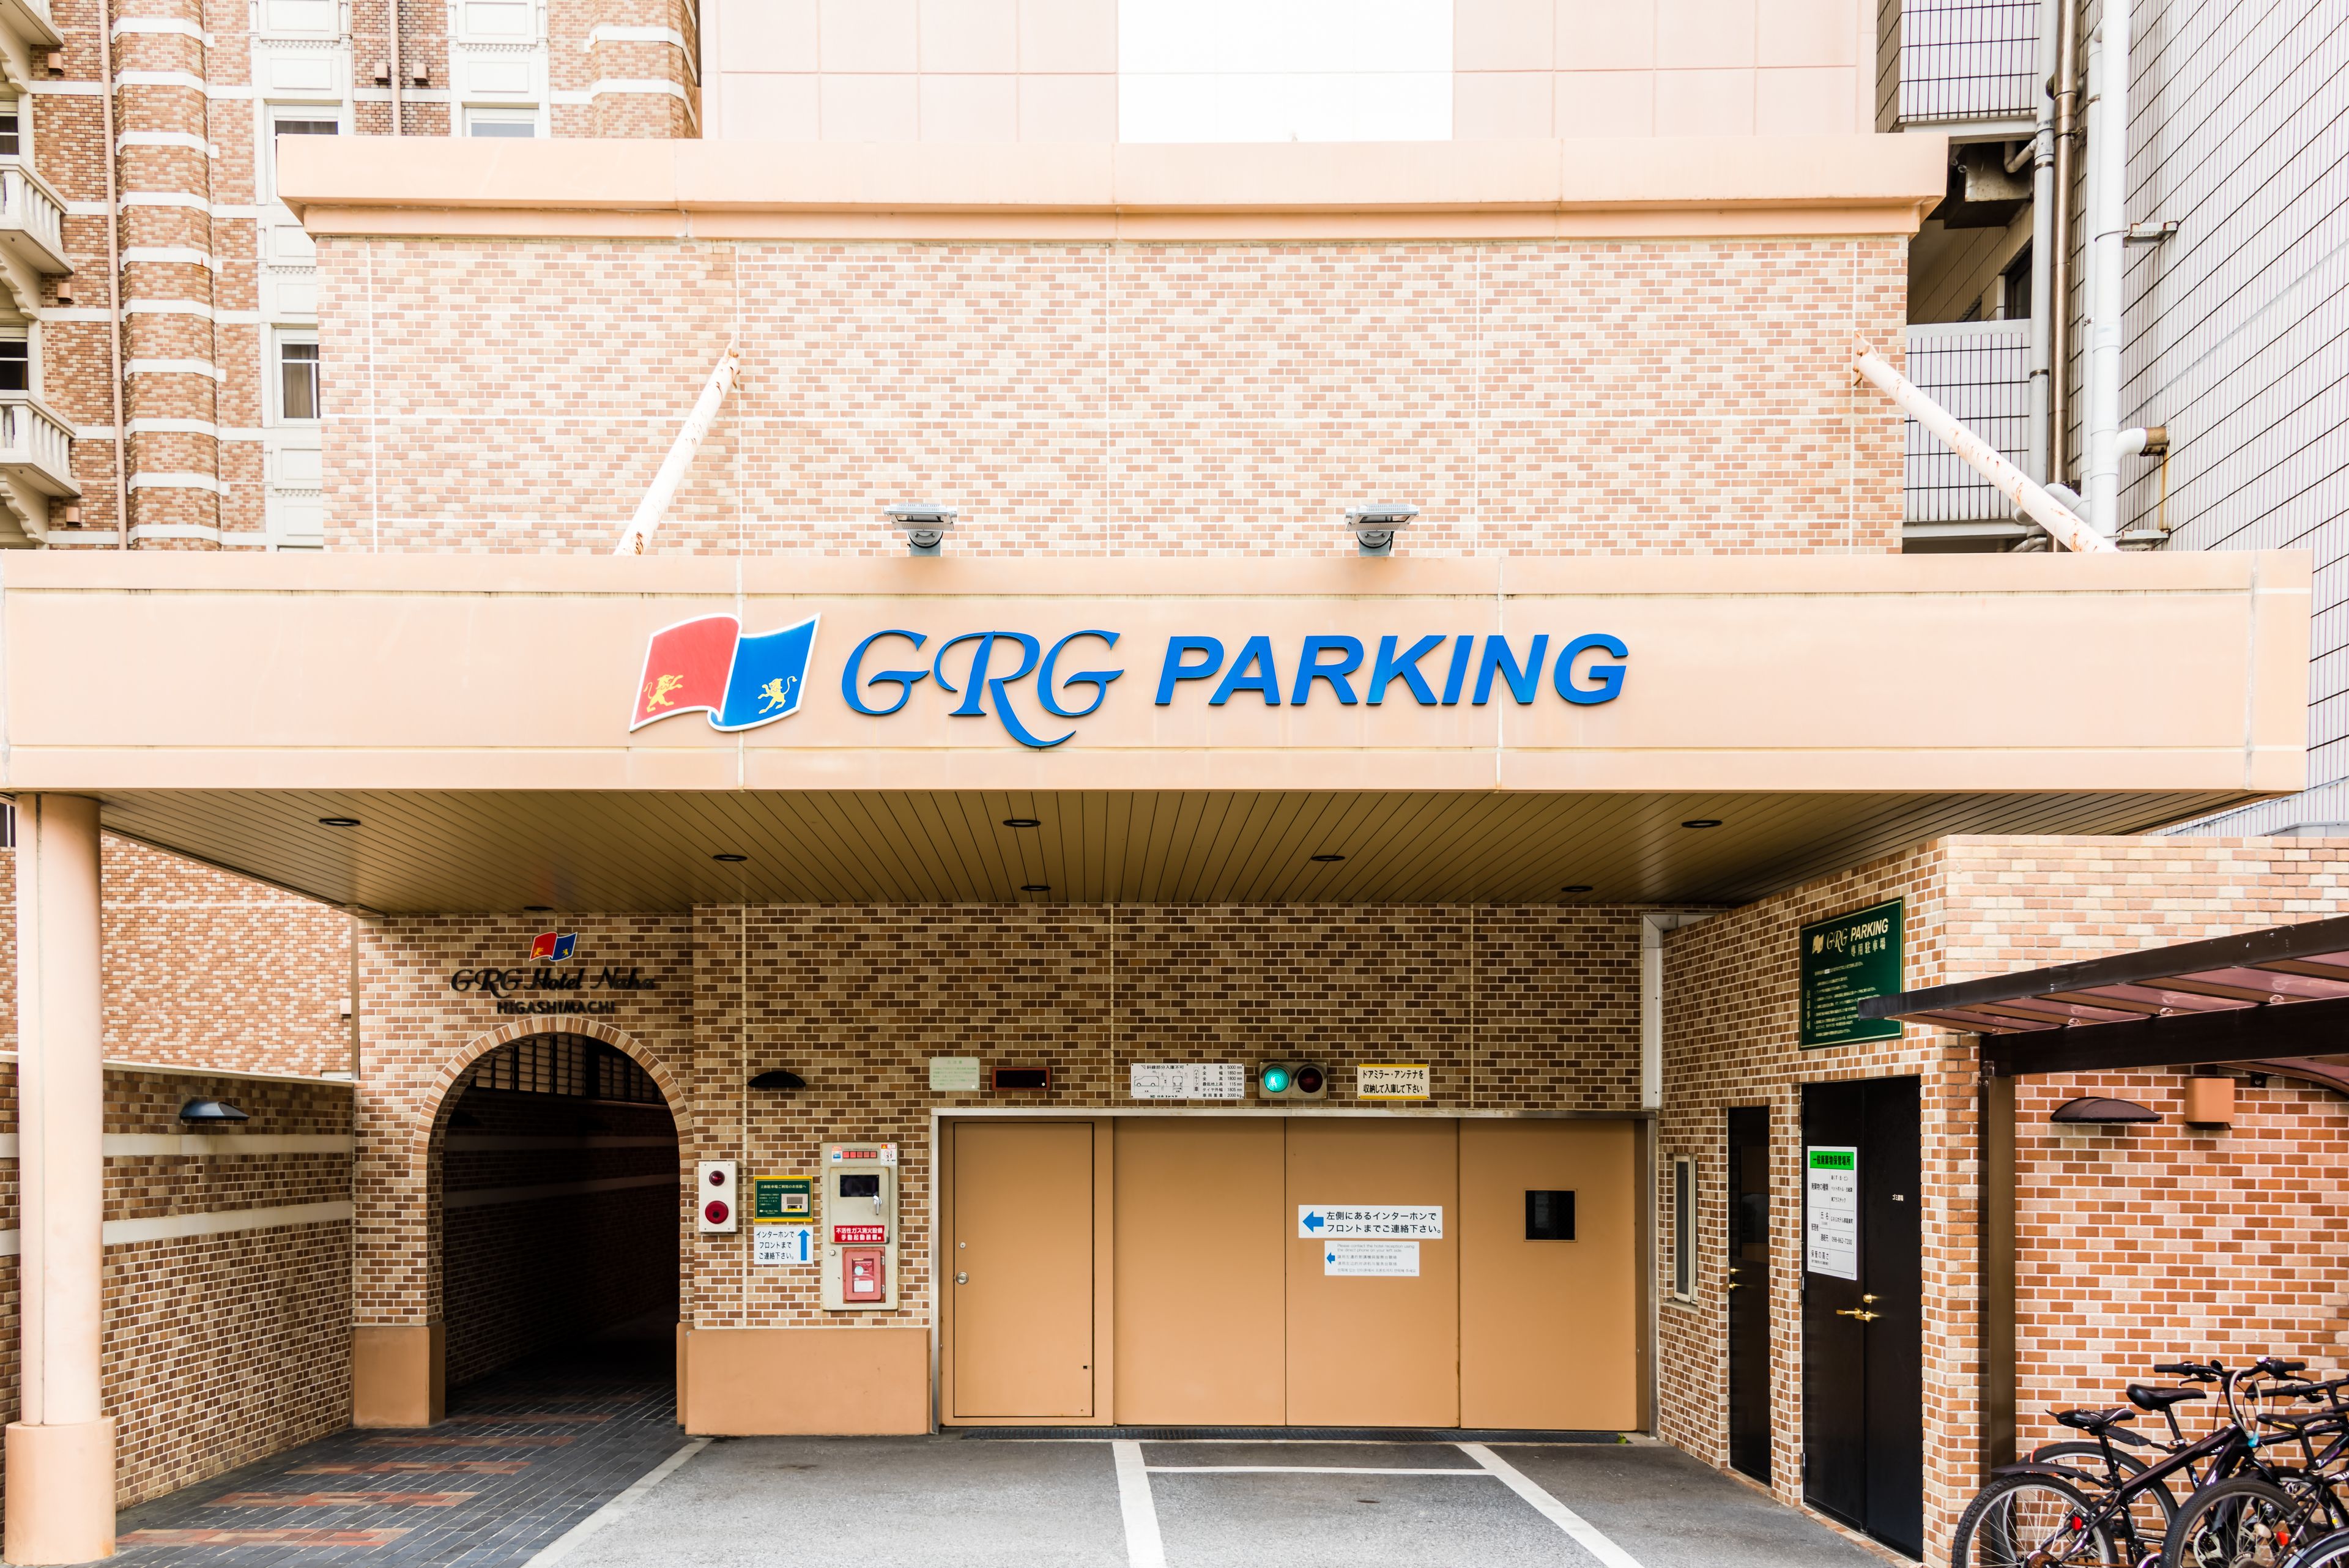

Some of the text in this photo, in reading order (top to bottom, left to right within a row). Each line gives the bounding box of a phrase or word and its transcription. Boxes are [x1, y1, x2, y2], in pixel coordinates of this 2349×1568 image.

[841, 630, 1628, 748] GRG PARKING
[1827, 918, 1888, 953] GRG PARKING
[450, 967, 656, 998] GRG Hotel Naha
[497, 1001, 615, 1014] HIGASHIMACHI
[1363, 1069, 1423, 1079] ドアミラー・アンテナを
[1326, 1211, 1437, 1220] 左側にあるインターホンで
[1327, 1224, 1441, 1233] フロントまでご連絡下さい。
